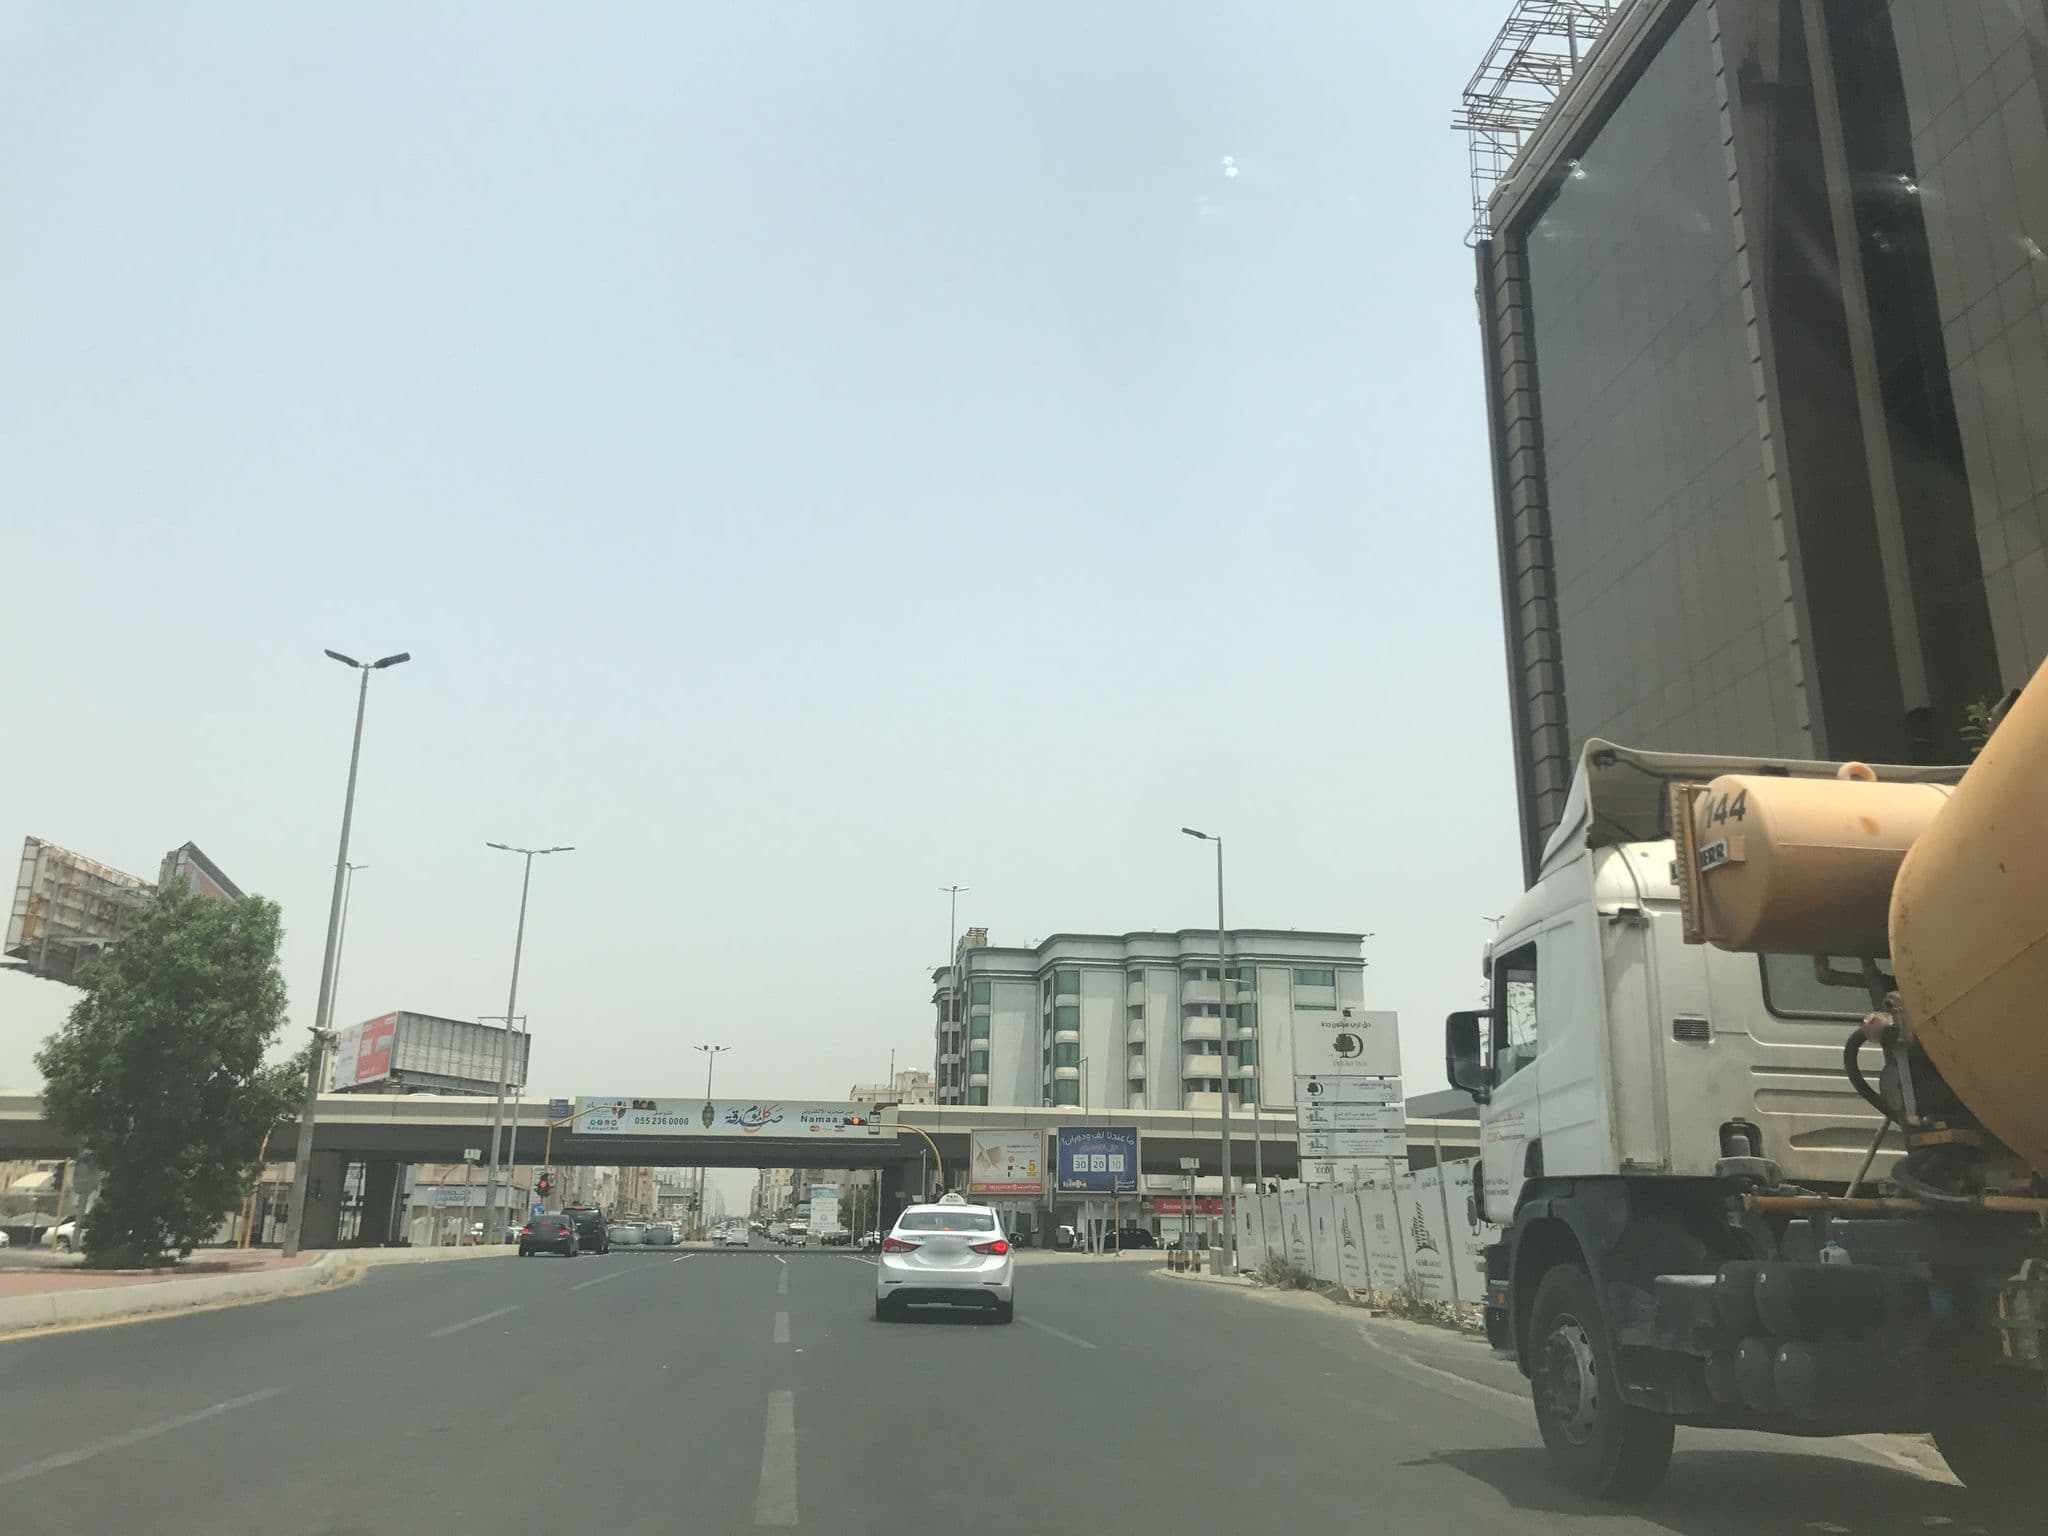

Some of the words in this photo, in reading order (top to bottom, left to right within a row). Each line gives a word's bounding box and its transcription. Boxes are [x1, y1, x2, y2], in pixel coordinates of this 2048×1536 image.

[1706, 789, 1747, 828] 144
[634, 1116, 650, 1125] 055
[651, 1117, 667, 1126] 236
[668, 1117, 689, 1126] 0000
[1029, 1159, 1036, 1172] 5
[1075, 1160, 1087, 1169] 30
[1093, 1161, 1104, 1169] 20
[1111, 1161, 1121, 1170] 10
